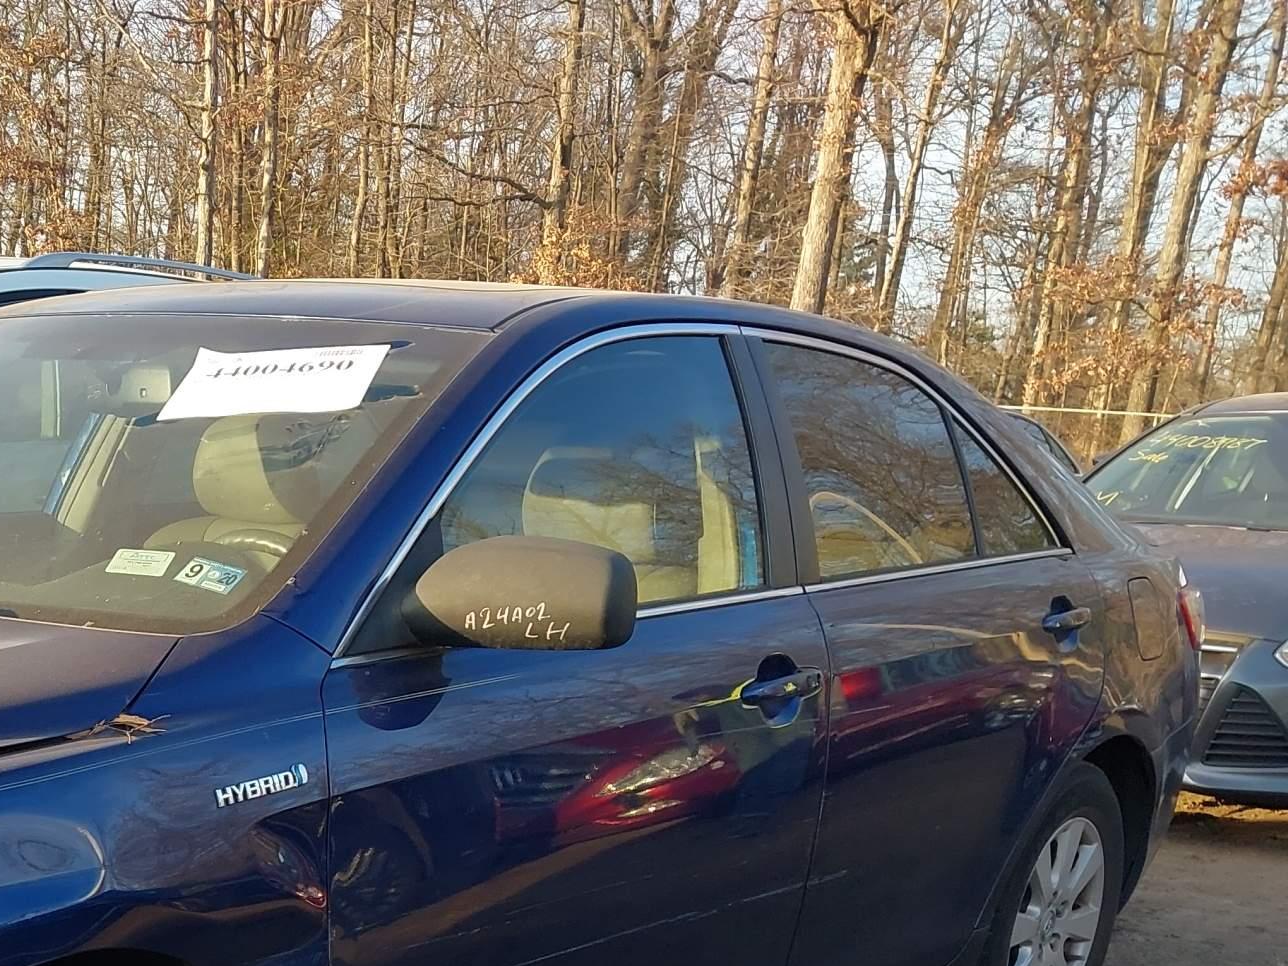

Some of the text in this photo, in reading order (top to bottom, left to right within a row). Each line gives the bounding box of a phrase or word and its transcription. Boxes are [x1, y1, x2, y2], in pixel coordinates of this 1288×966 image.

[206, 359, 354, 379] 44004690
[184, 563, 204, 579] 9
[216, 572, 238, 586] 20
[464, 601, 551, 630] A24A02
[215, 770, 298, 808] HYBRID
